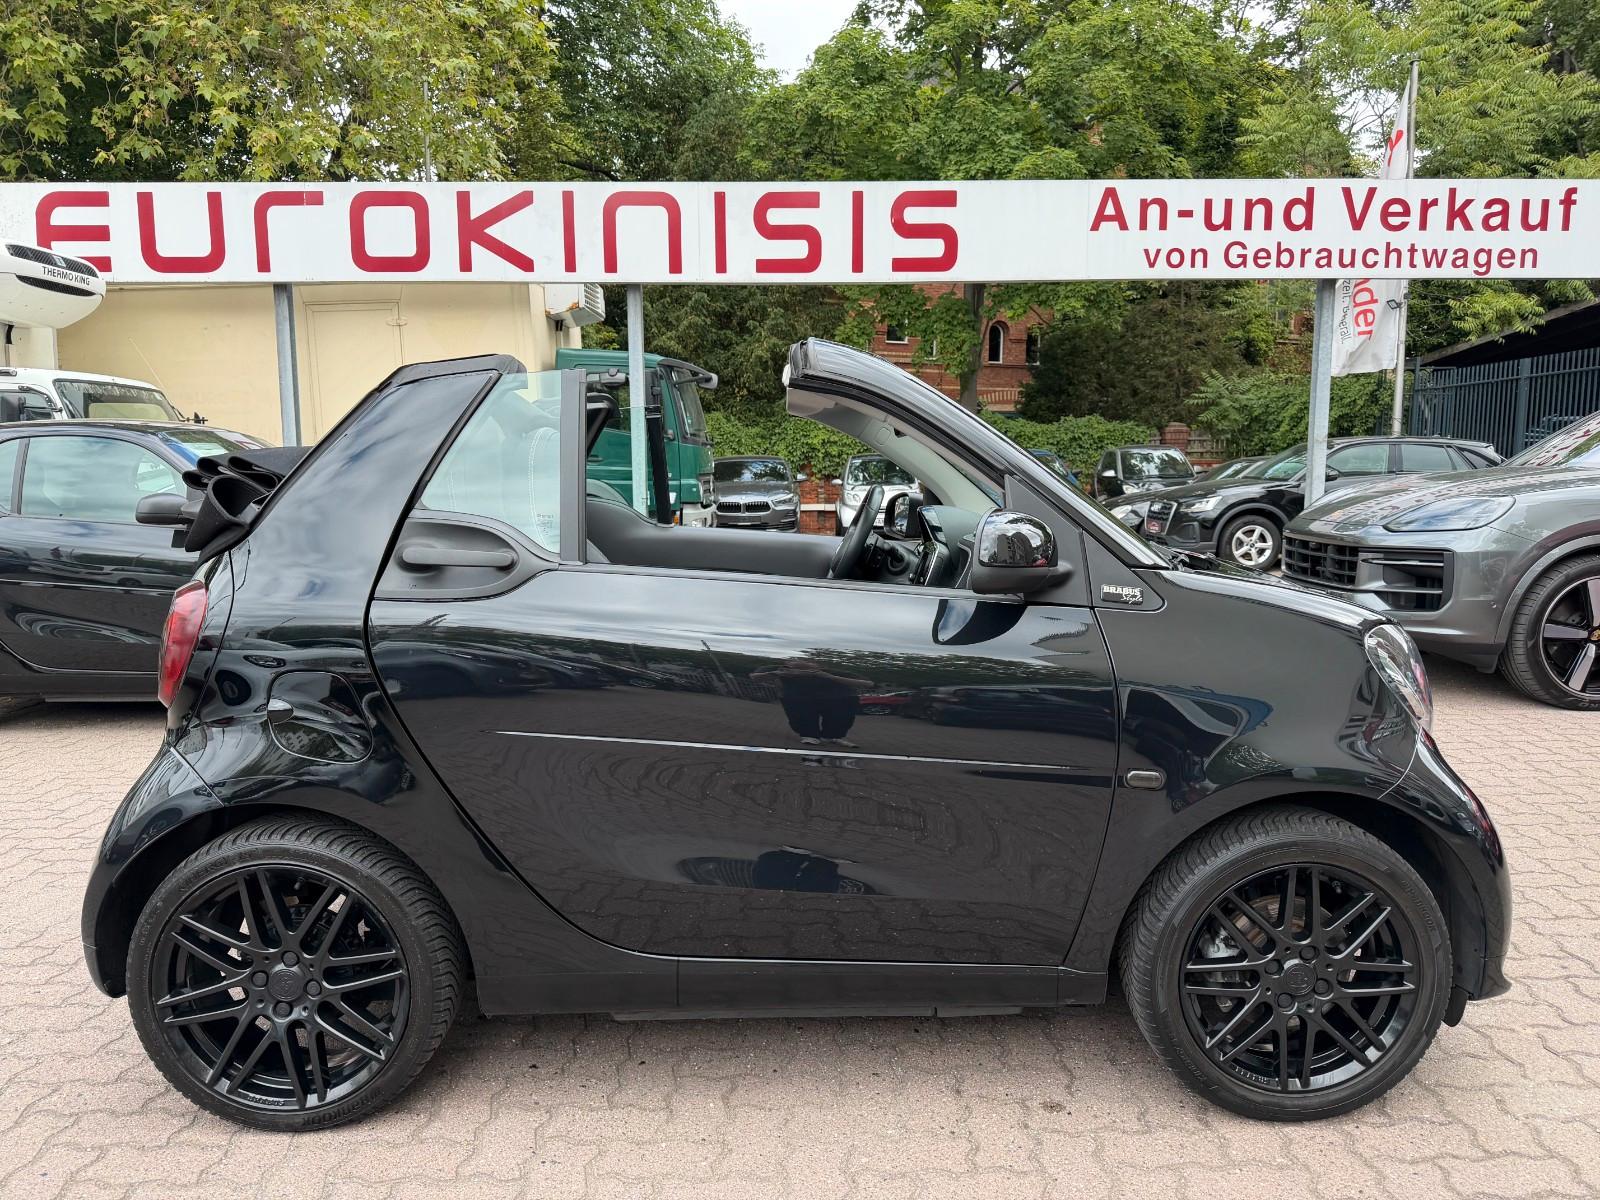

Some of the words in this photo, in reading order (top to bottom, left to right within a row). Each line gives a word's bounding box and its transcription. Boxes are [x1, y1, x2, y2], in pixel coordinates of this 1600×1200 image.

[1091, 187, 1314, 231] An-und
[1343, 187, 1577, 232] Verkauf
[1144, 247, 1208, 269] von
[1223, 242, 1537, 276] Gebrauchtwagen
[42, 265, 74, 282] THERMO
[74, 274, 90, 286] KING
[1102, 585, 1141, 596] BRABUS
